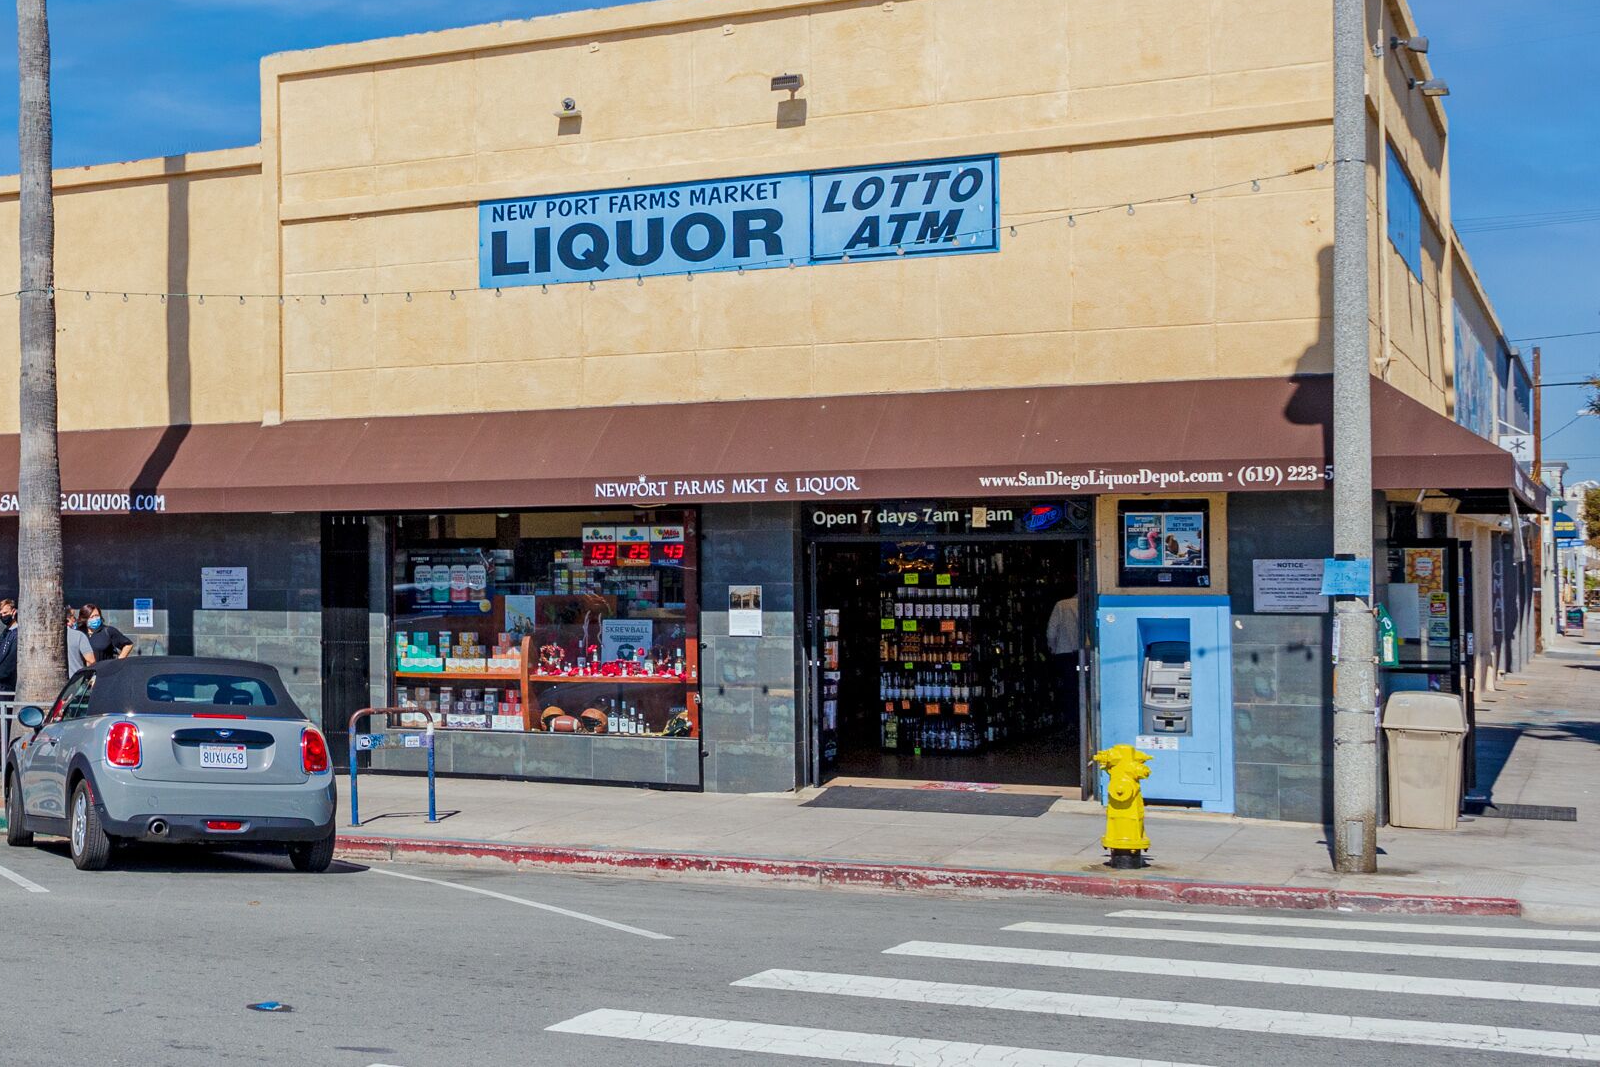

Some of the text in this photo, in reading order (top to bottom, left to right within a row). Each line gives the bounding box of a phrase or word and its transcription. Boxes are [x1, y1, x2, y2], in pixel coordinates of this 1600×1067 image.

[492, 180, 782, 222] NEW PORT FARMS MARKET
[822, 167, 984, 213] LOTTO
[843, 208, 964, 250] ATM
[491, 209, 784, 276] LIQUOR
[595, 476, 860, 497] NEWPORT FARMS MKT & LIQUOR
[979, 465, 1334, 489] www.SanDiegoLiquorDepot.com (619) 223-5
[0, 493, 166, 512] SAGOLIQUOR.COM
[813, 511, 857, 527] Open
[862, 510, 872, 523] 7
[877, 510, 918, 526] days
[923, 508, 959, 522] 7am
[591, 544, 684, 559] 123 25 43
[203, 752, 244, 764] 8UXU658
